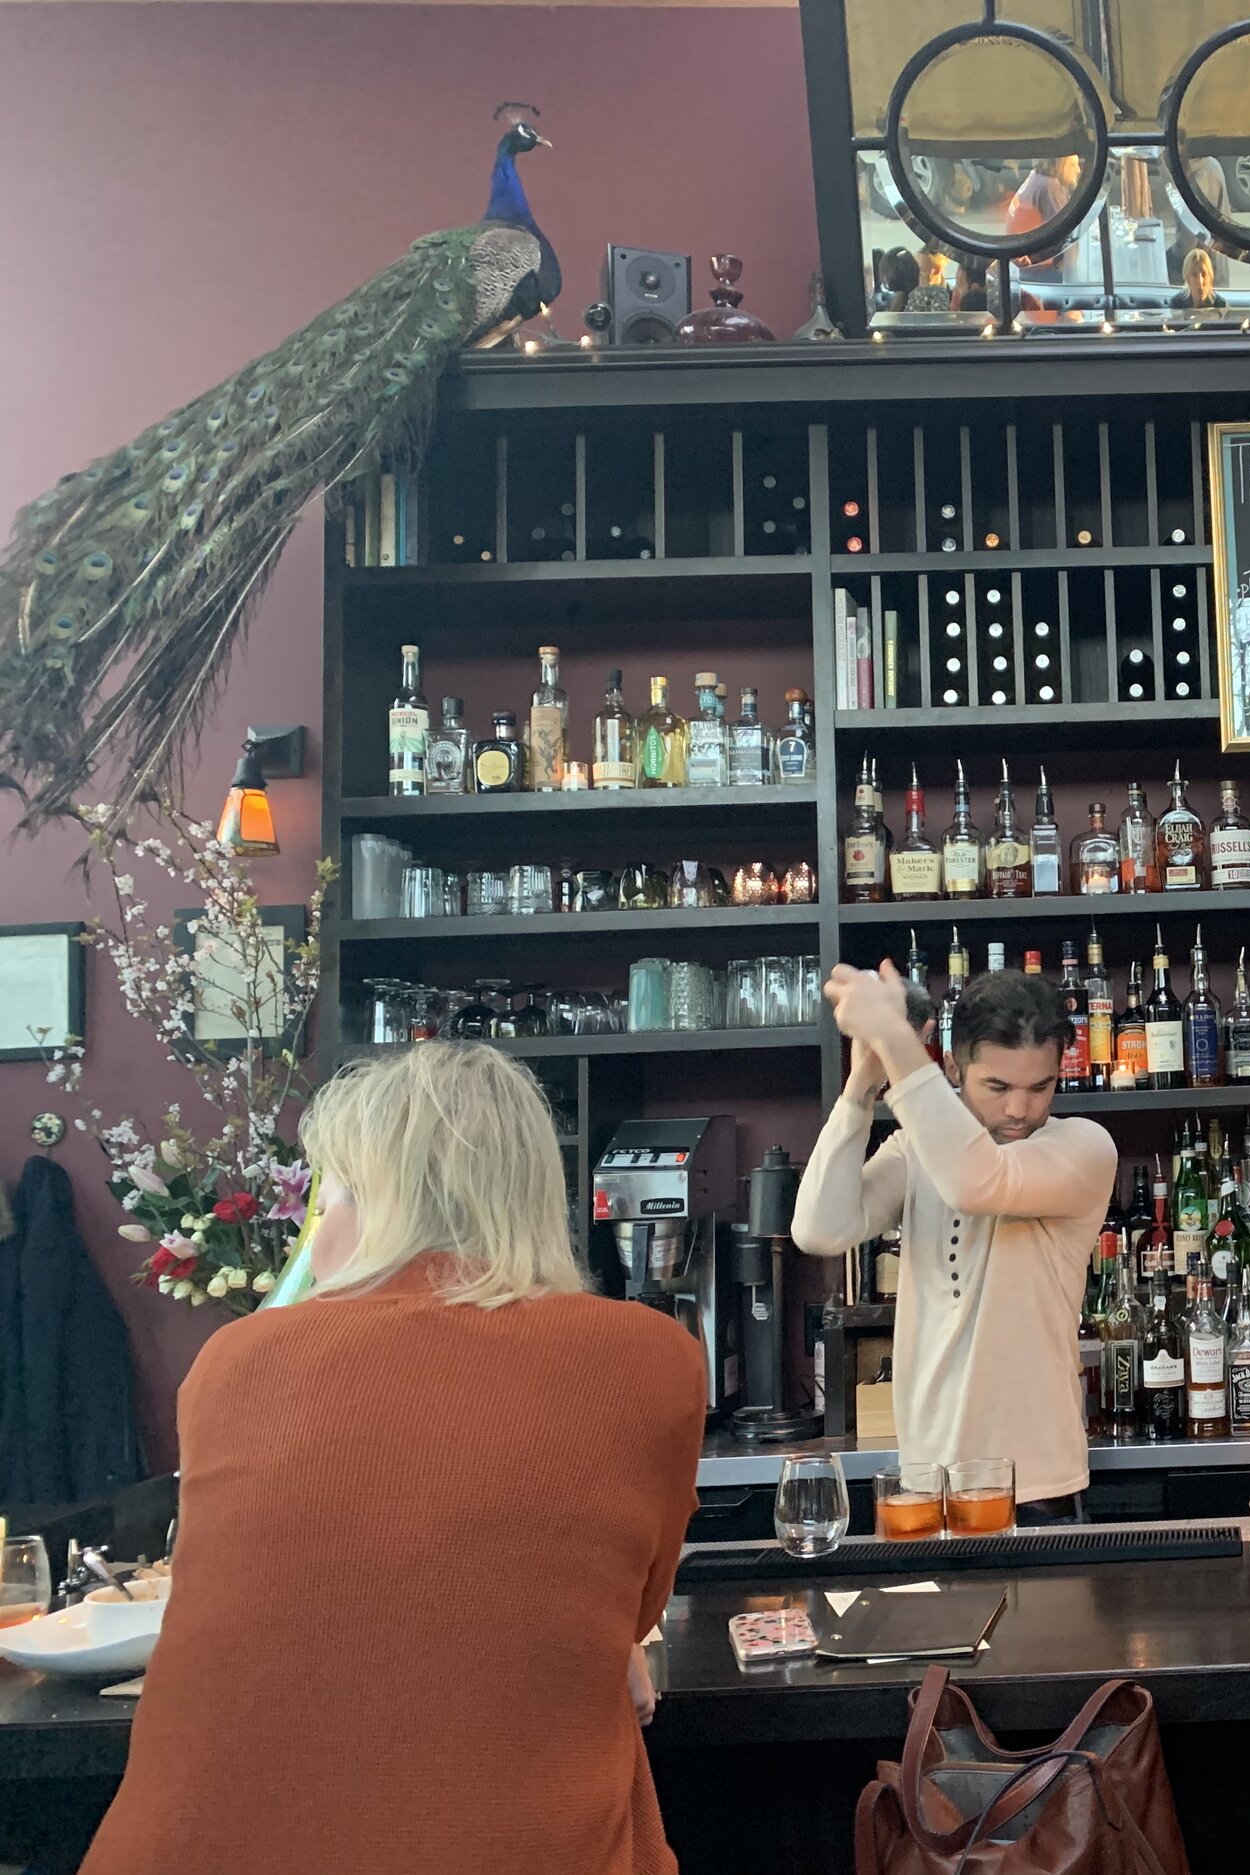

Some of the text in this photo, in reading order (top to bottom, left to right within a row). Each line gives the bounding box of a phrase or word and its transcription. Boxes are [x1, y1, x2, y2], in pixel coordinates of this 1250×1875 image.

[788, 741, 796, 752] 7
[1165, 823, 1193, 834] ELIJAH
[1165, 833, 1193, 844] CRAIG
[1229, 870, 1239, 879] 10
[645, 1201, 681, 1210] Millenia
[1115, 1355, 1131, 1393] Zaya
[1232, 1370, 1246, 1383] JACK
